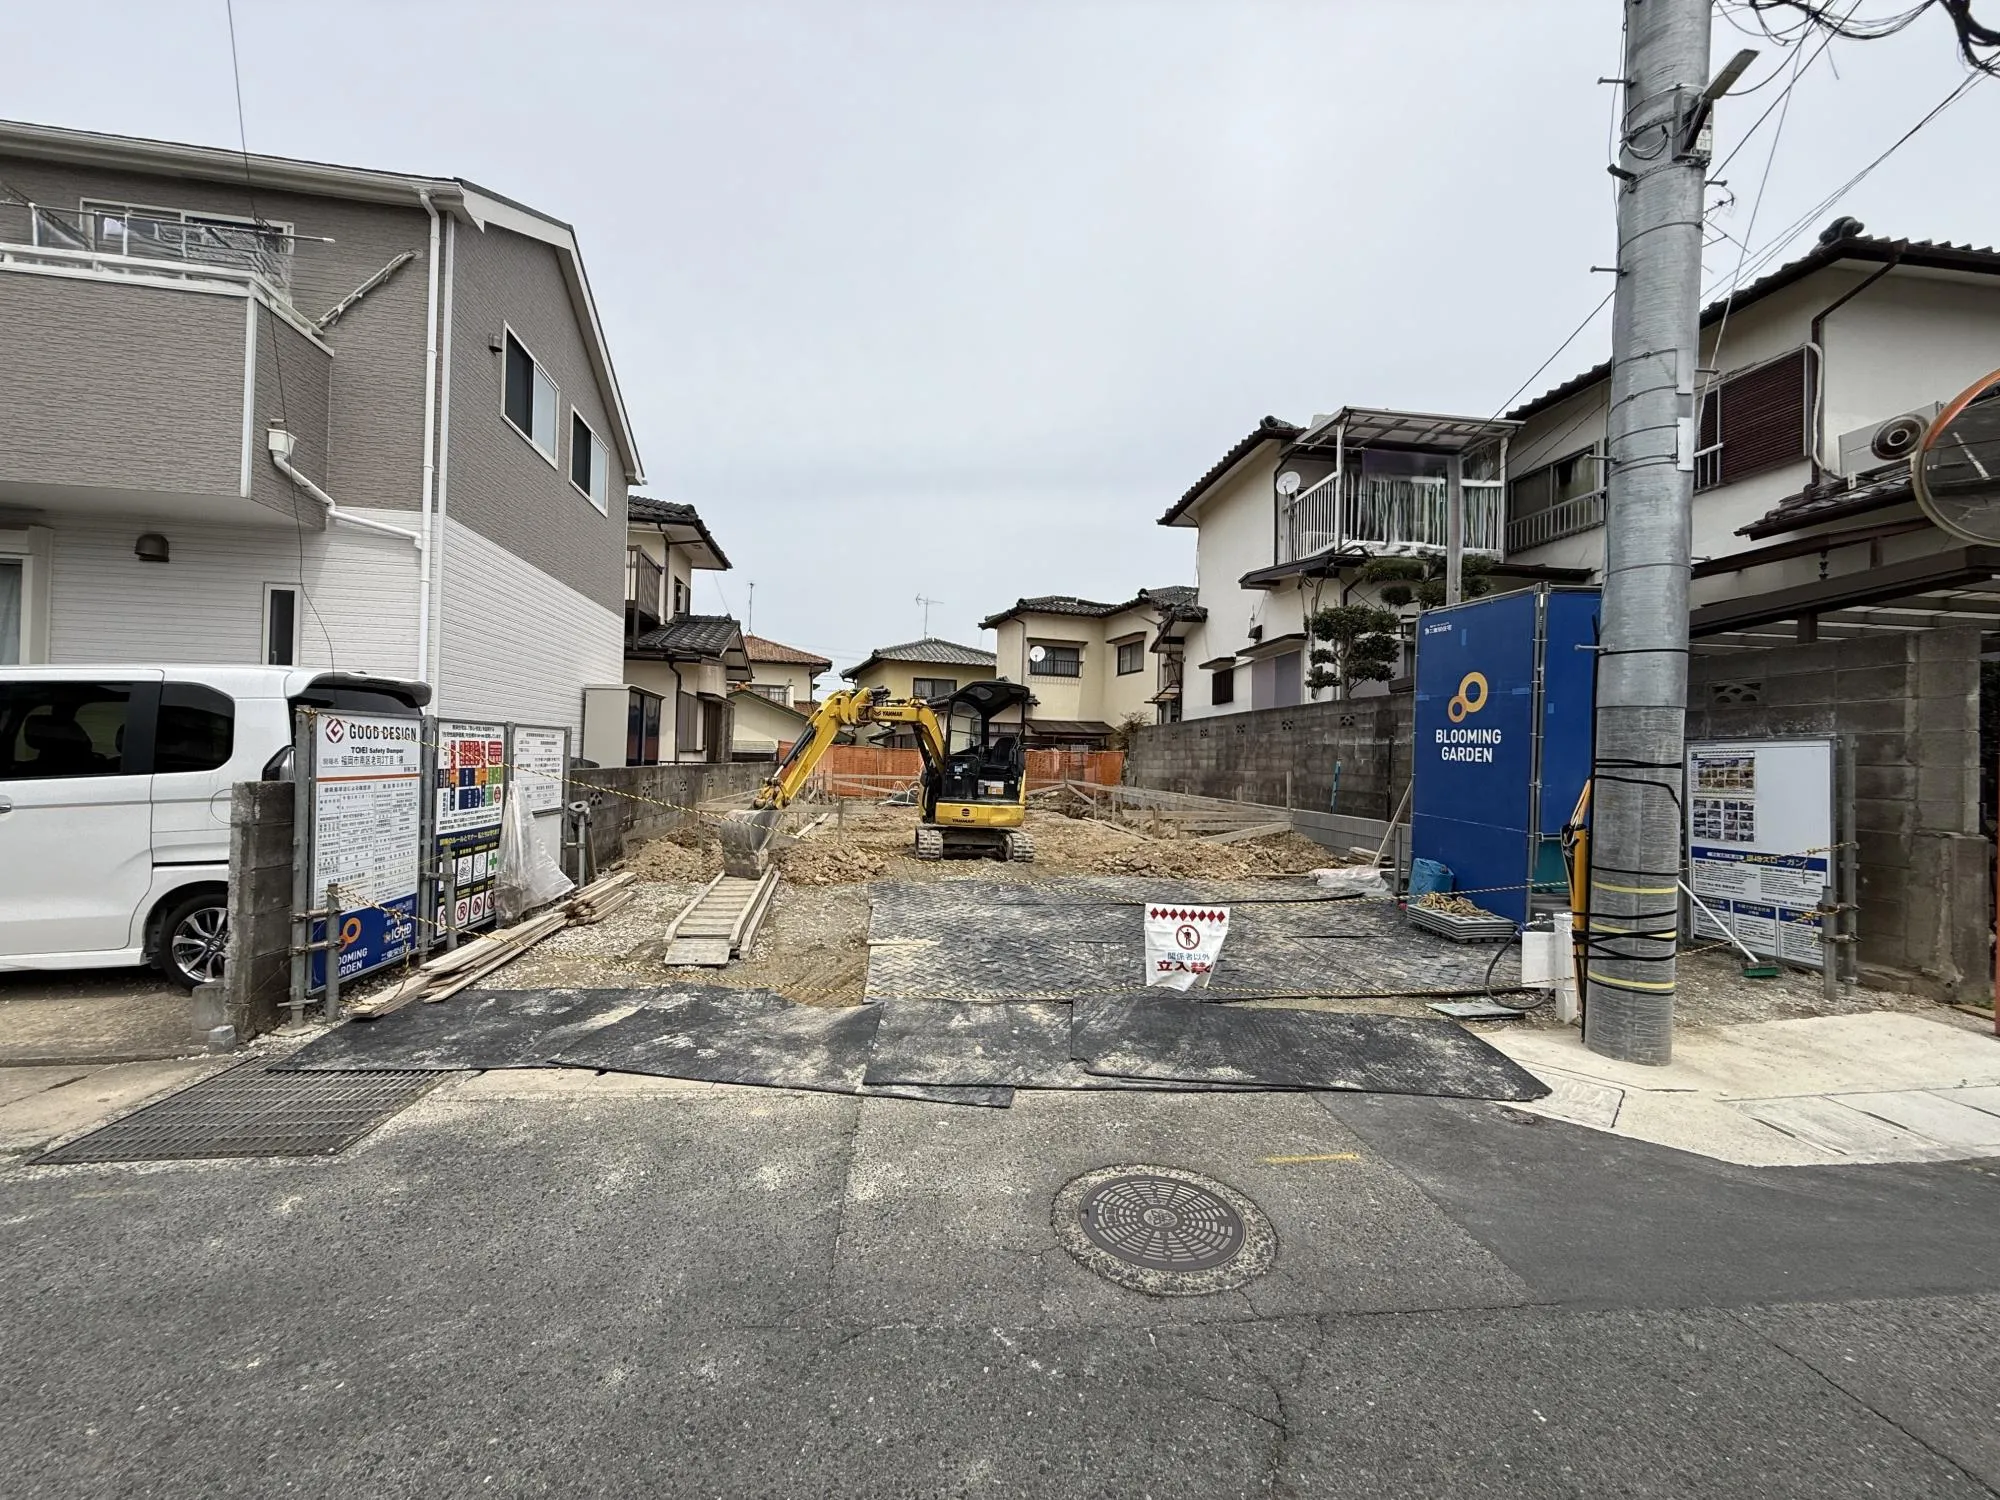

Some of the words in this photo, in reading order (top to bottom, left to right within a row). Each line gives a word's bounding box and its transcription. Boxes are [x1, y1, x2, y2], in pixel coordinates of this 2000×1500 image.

[349, 724, 379, 740] GOOD
[383, 726, 416, 741] DESIGN
[1435, 729, 1502, 744] BLOOMING
[350, 746, 368, 754] TOEI
[369, 747, 386, 755] Safety
[1441, 746, 1492, 762] GARDEN
[338, 947, 368, 966] OMING
[1167, 951, 1210, 961] 関係者以外
[338, 960, 363, 977] RDEN
